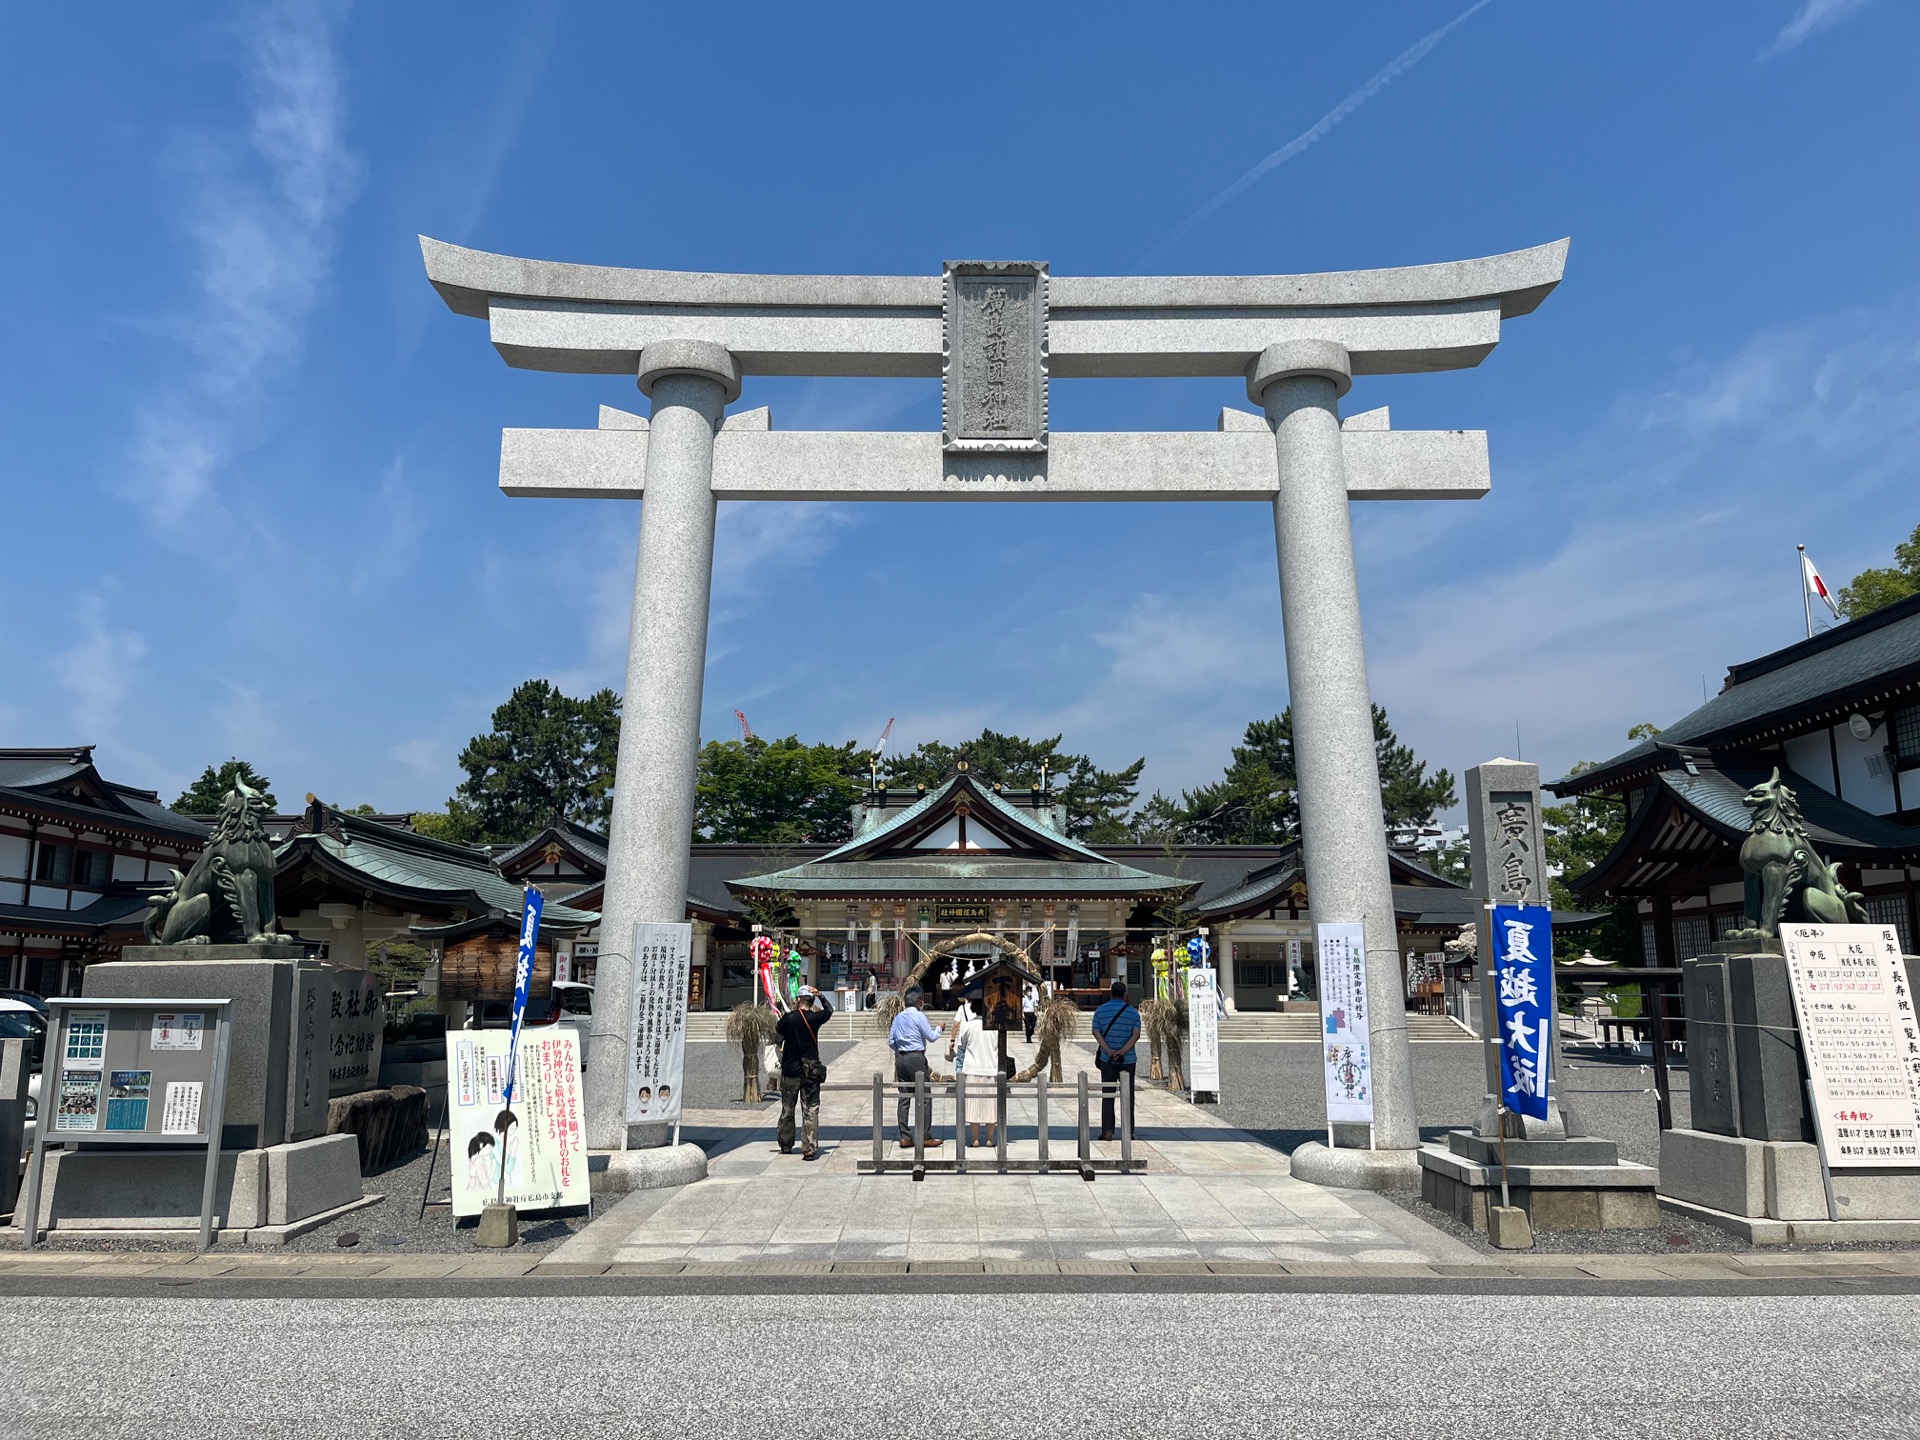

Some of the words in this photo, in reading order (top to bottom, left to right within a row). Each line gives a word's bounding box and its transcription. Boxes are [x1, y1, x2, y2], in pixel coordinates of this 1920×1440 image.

[981, 286, 1009, 431] 廣島護國神社
[1493, 801, 1531, 899] 廣島
[674, 954, 686, 1032] ご参拝の皆様へお願い
[1809, 949, 1826, 960] 中厄
[1809, 983, 1817, 991] 女
[330, 1032, 376, 1056] 竣功記念
[541, 1040, 556, 1139] おまつりしましょう
[552, 1039, 570, 1187] 伊勢神宮と廣島護國神社のお札を
[563, 1039, 579, 1152] みんなの幸せを願って
[482, 1191, 564, 1206] 広島神社庁広島市支部
